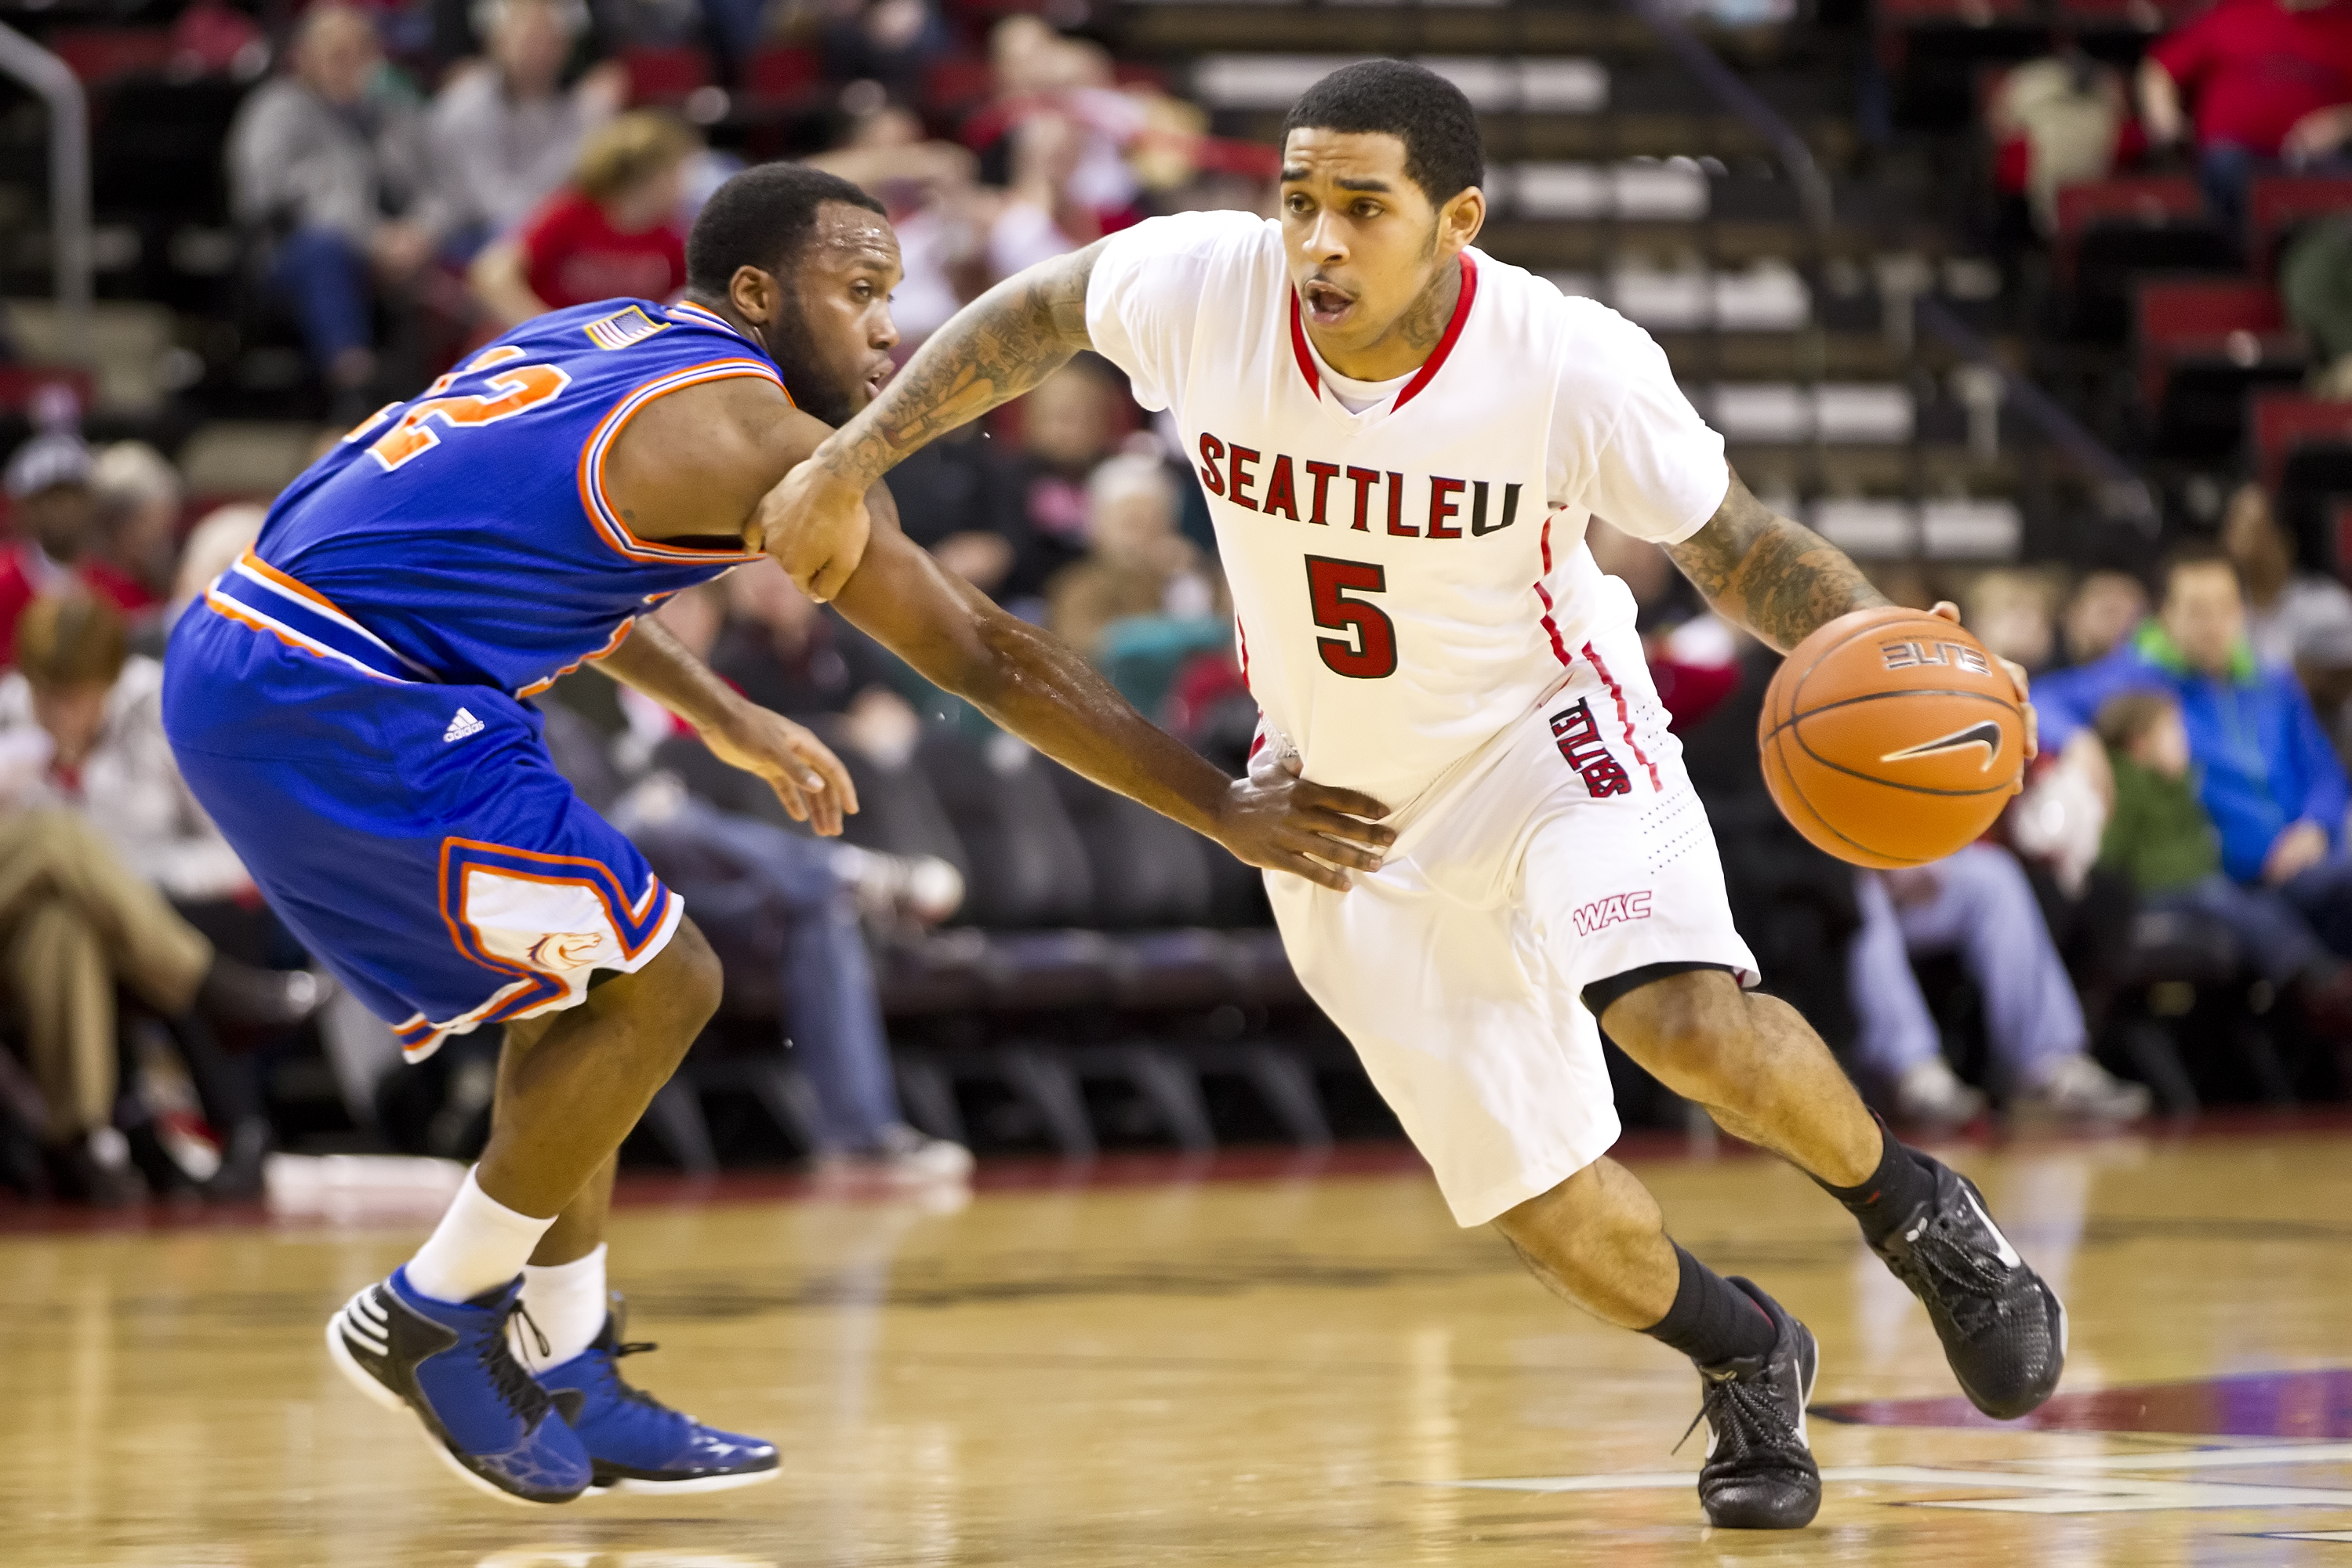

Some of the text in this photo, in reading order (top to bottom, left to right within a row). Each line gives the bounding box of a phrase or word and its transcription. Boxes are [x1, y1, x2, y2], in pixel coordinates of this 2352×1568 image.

[1200, 432, 1523, 539] SEATTLEU
[1305, 554, 1398, 679] 5
[1882, 641, 1993, 677] ELITE
[443, 720, 485, 743] adidas
[1573, 890, 1652, 937] WAC
